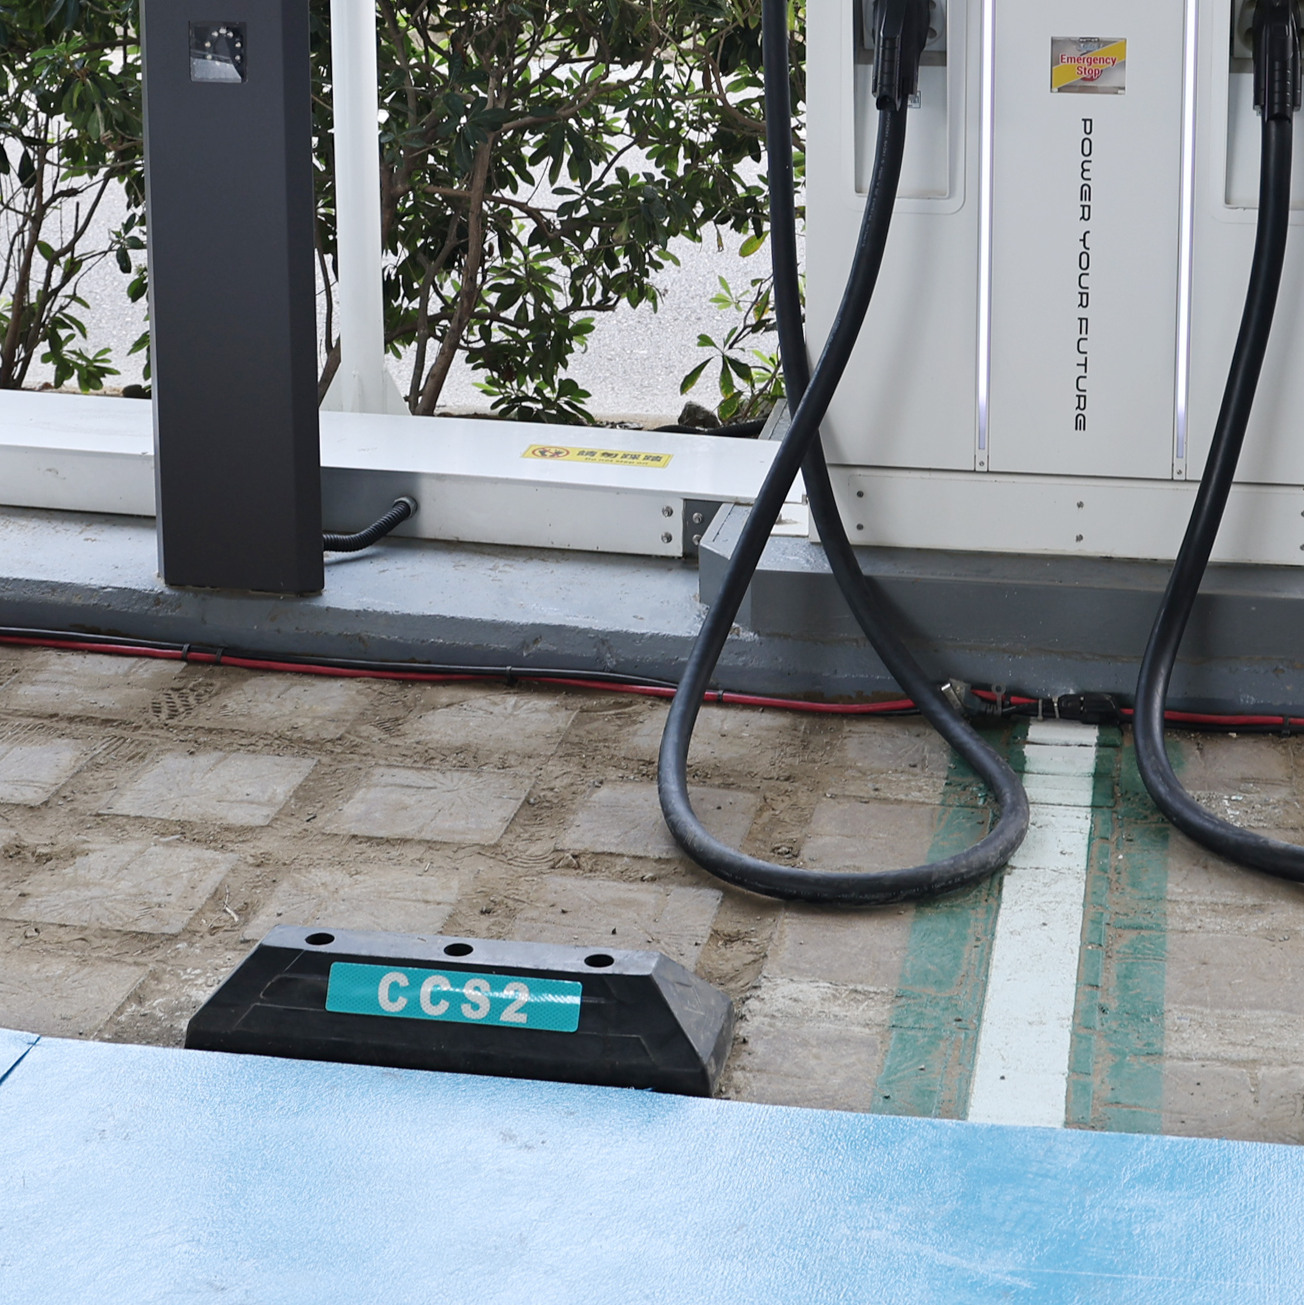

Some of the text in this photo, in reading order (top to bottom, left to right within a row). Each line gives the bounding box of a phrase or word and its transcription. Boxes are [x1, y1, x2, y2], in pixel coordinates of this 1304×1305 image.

[1060, 54, 1117, 67] Emergency
[1076, 66, 1101, 78] Stop
[1075, 118, 1093, 432] POWER YOUR FUTURE
[377, 972, 529, 1023] CCS2
